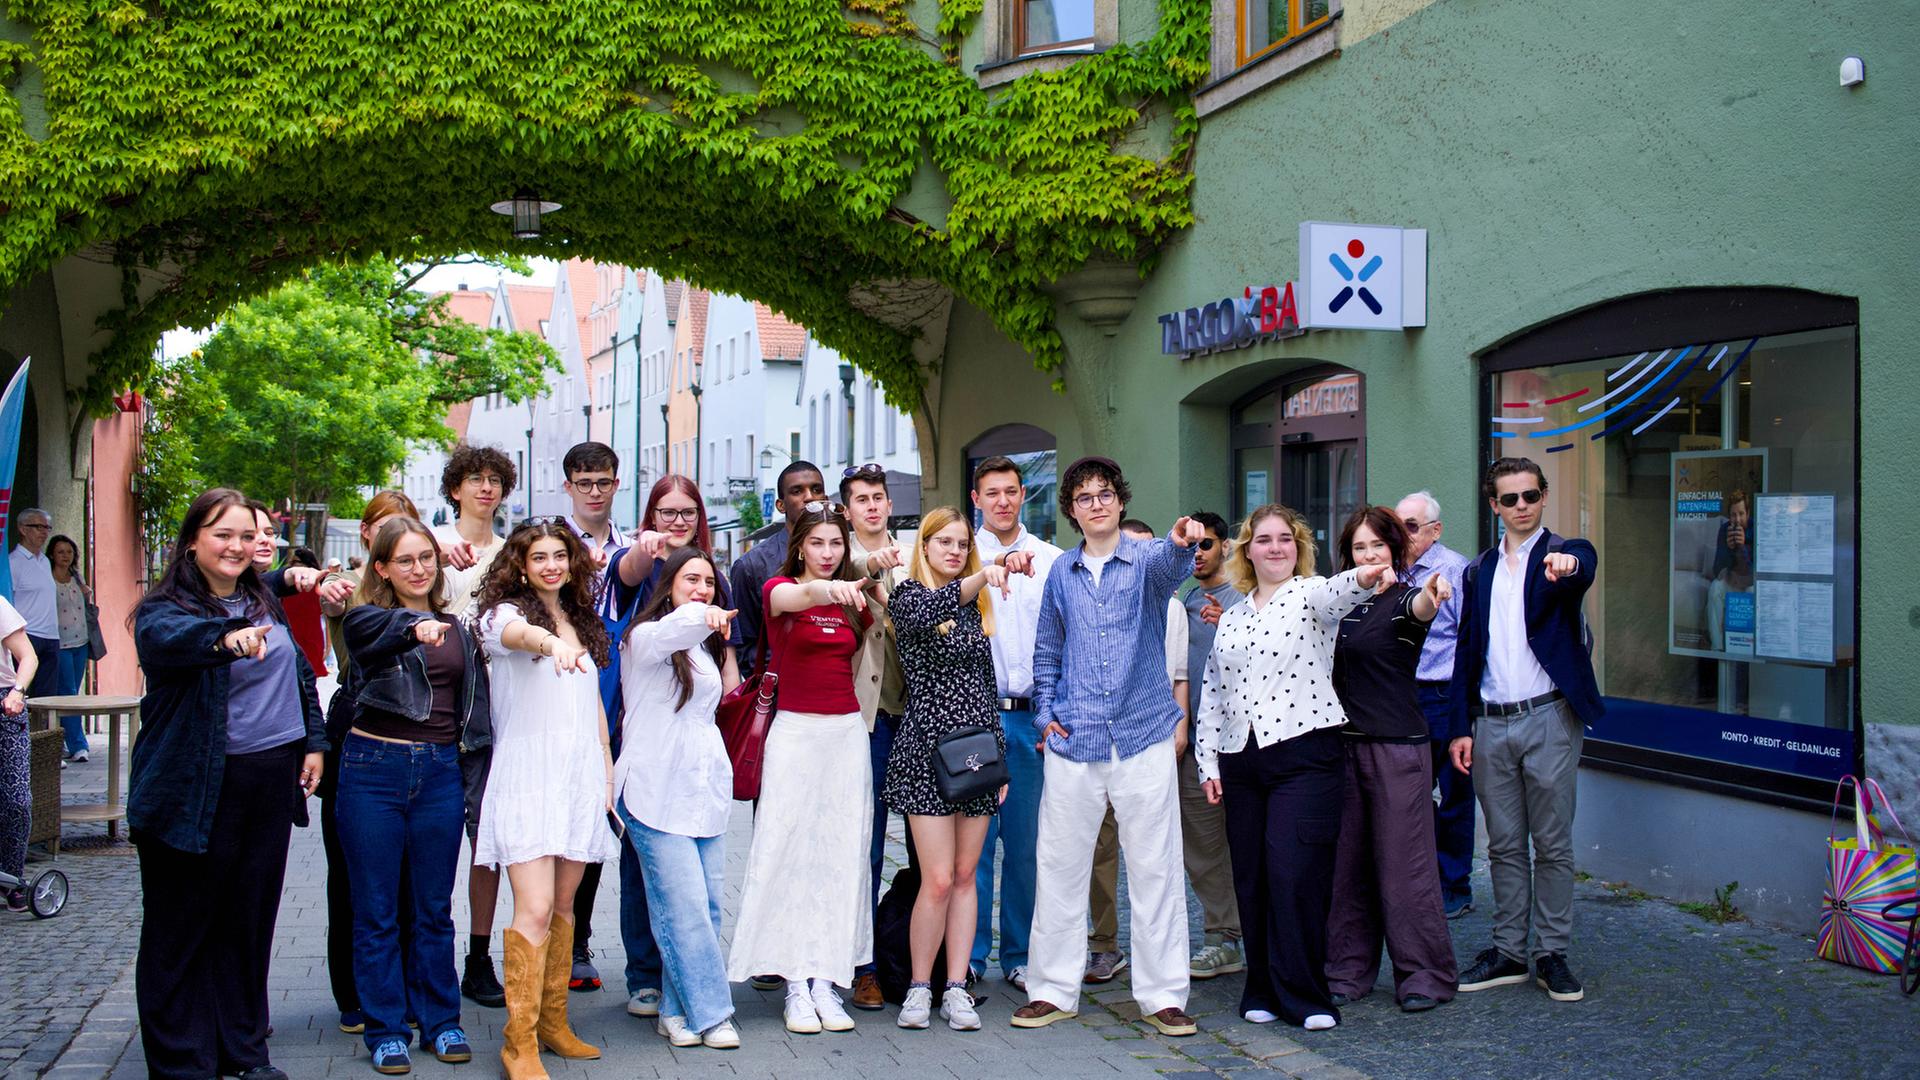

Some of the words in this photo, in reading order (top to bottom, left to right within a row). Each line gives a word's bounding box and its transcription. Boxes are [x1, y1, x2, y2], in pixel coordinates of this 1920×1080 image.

[1260, 281, 1300, 334] BA
[1678, 491, 1706, 500] EINFACH
[1708, 490, 1723, 500] MAL
[1678, 501, 1720, 511] RATENPAUSE
[1677, 512, 1707, 521] MACHEN
[1721, 730, 1749, 743] KONTO
[1753, 735, 1781, 748] KREDIT
[1786, 741, 1841, 757] GELDANLAGE
